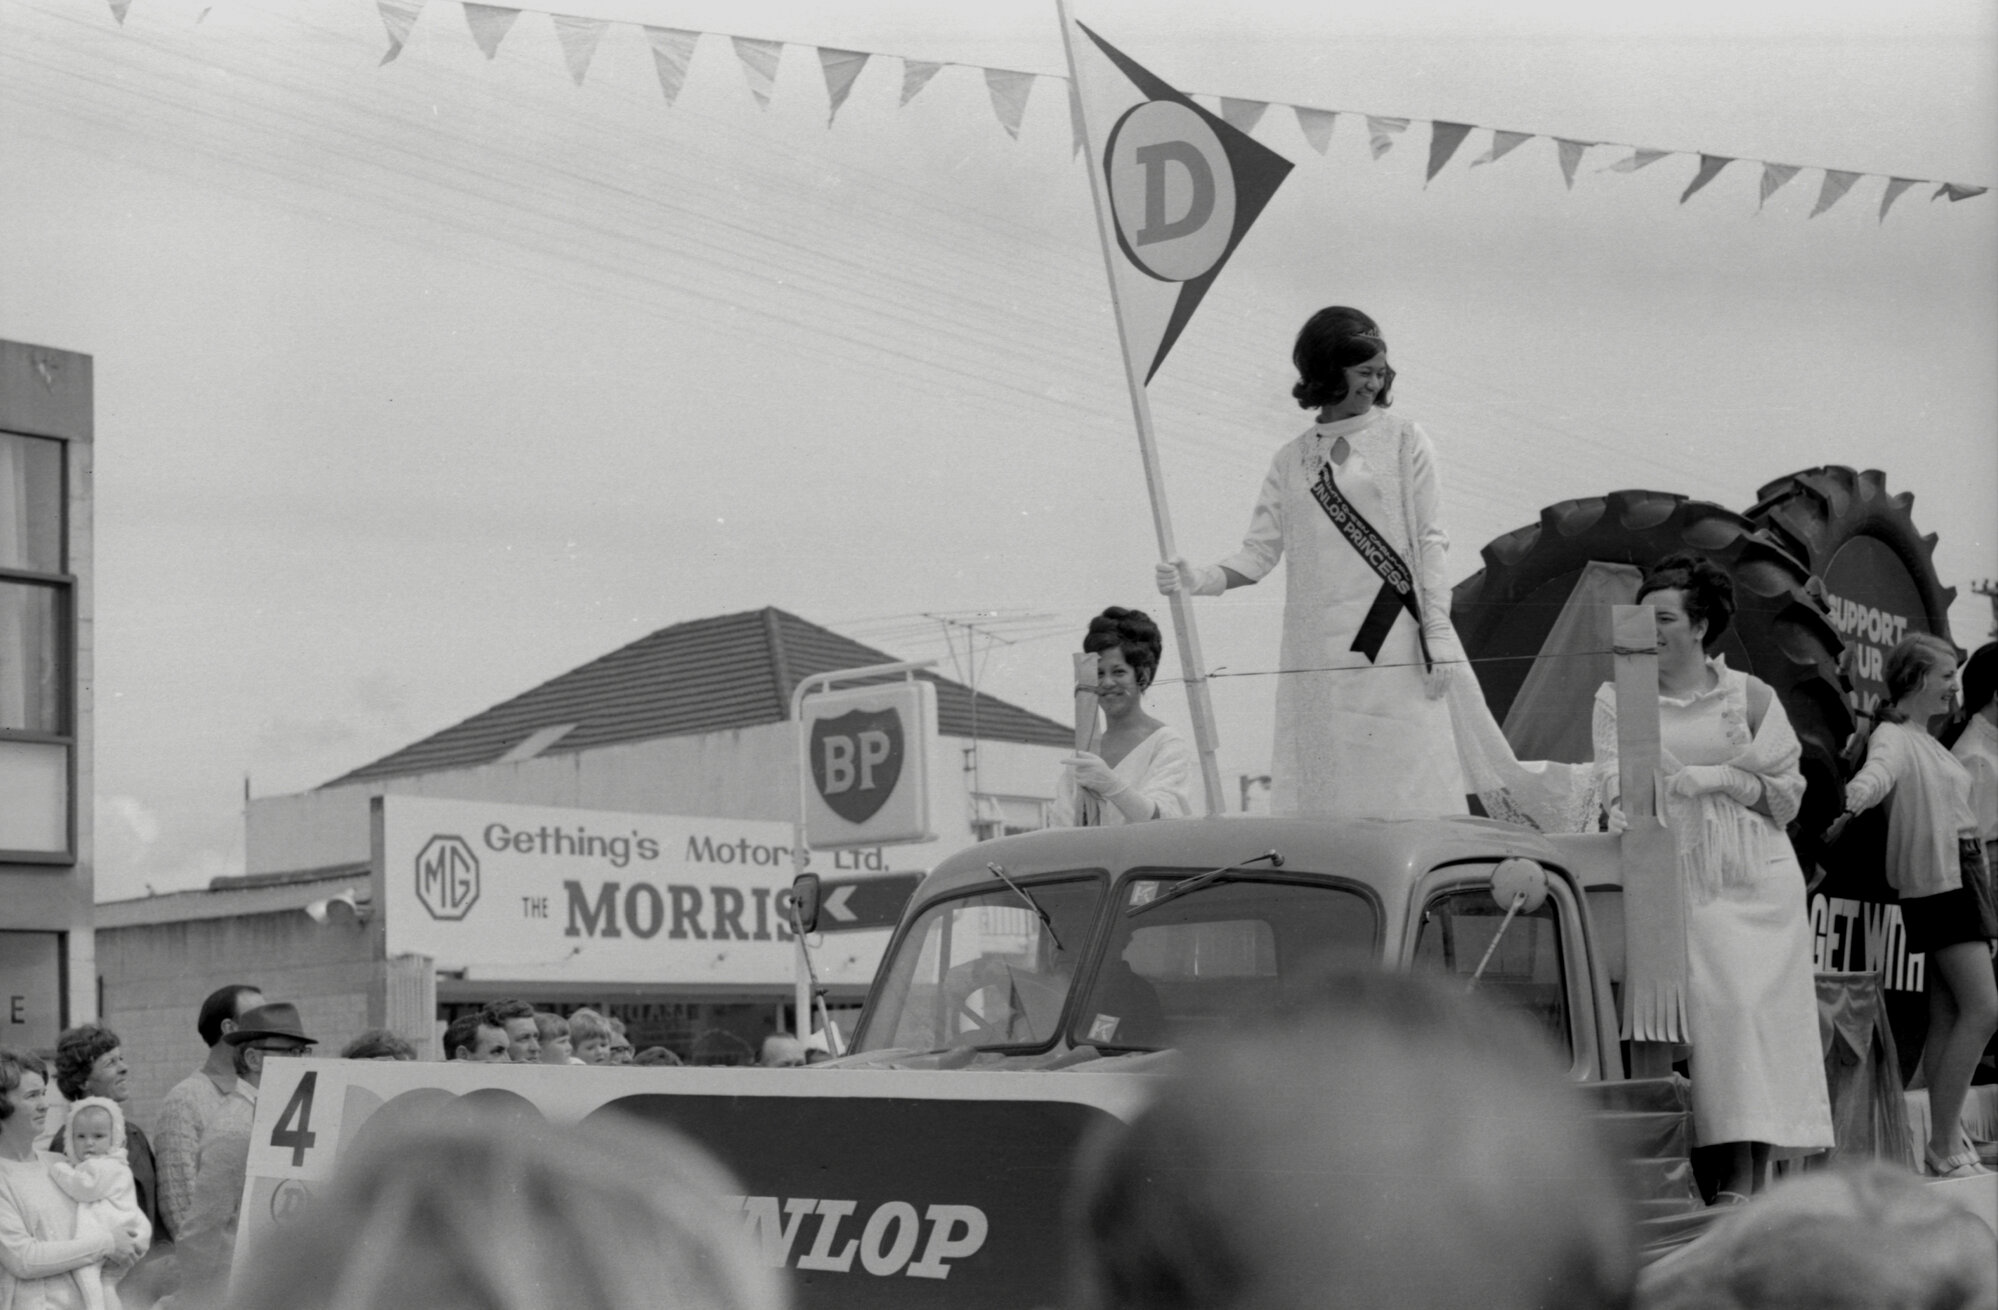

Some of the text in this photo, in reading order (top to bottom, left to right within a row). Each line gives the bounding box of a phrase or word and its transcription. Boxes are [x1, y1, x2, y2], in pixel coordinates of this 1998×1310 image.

[1136, 140, 1216, 247] D
[1312, 482, 1347, 523] UNLOP
[1343, 520, 1411, 596] PRINCESS
[1827, 593, 1908, 648] SUPPORT
[1857, 642, 1883, 682] UR
[822, 730, 891, 795] BP
[425, 844, 471, 909] MG
[483, 823, 890, 871] Gething's Motors Ltd.
[522, 879, 796, 942] THE MORRIS
[1809, 892, 1861, 973] GET
[11, 995, 25, 1025] E
[269, 1070, 318, 1168] 4
[740, 1195, 989, 1280] NLOP
